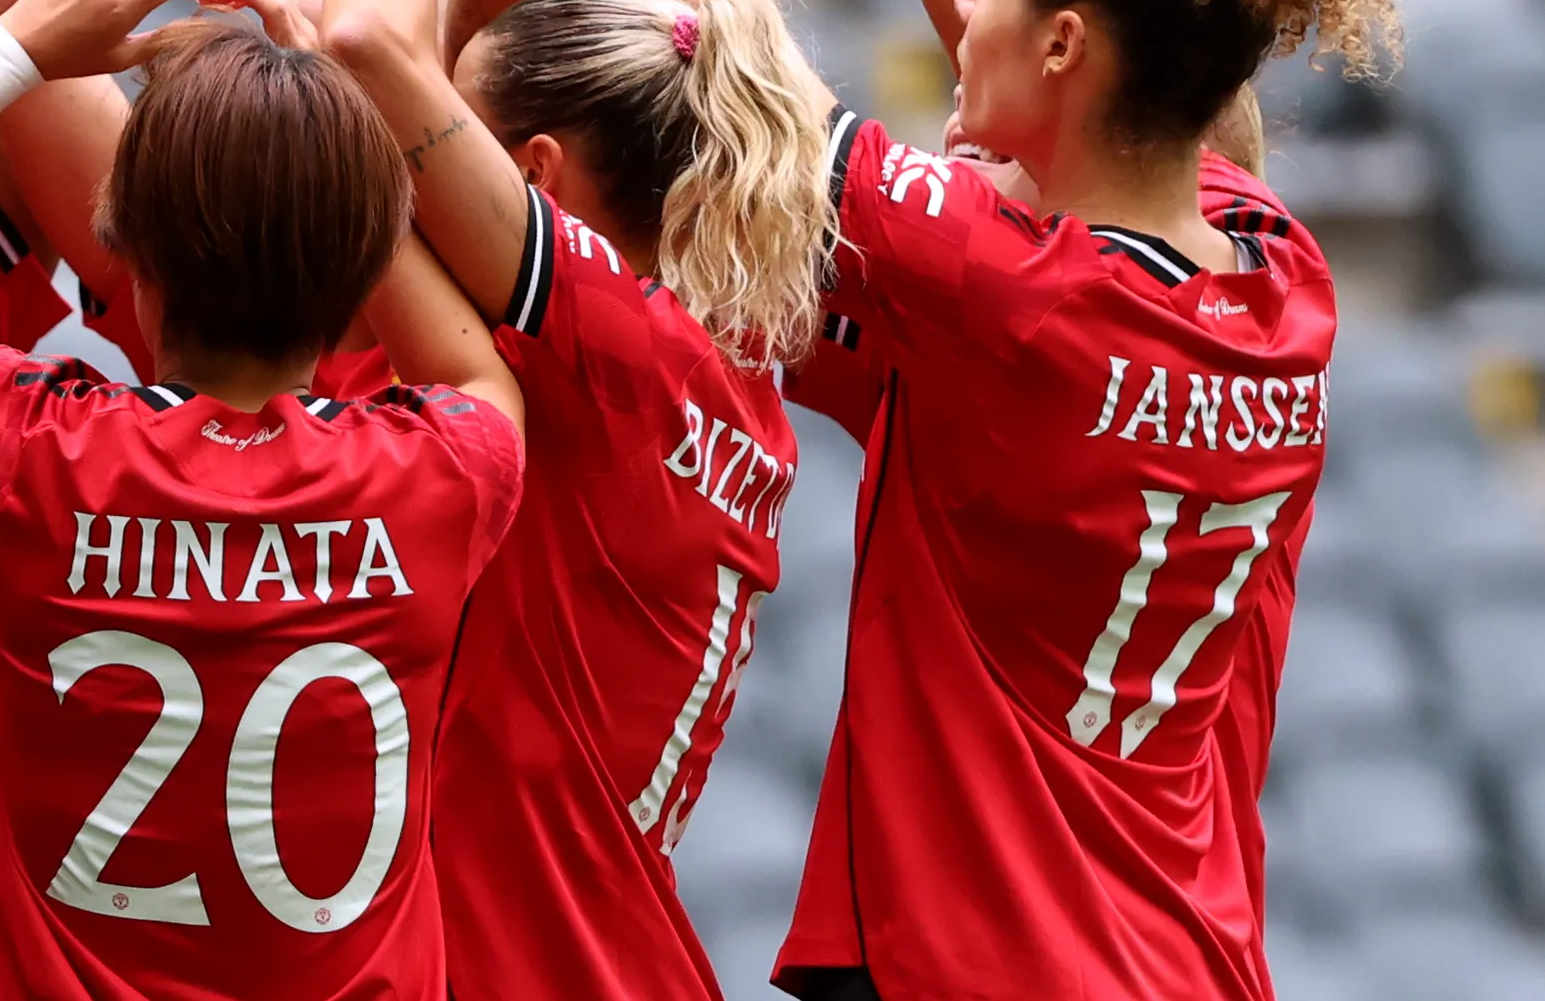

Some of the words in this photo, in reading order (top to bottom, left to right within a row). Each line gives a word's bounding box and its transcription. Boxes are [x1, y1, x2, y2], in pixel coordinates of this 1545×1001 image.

[200, 418, 238, 445] Theatre
[234, 432, 256, 452] of
[66, 511, 415, 604] HINATA
[1065, 489, 1292, 760] 17
[45, 630, 410, 933] 20
